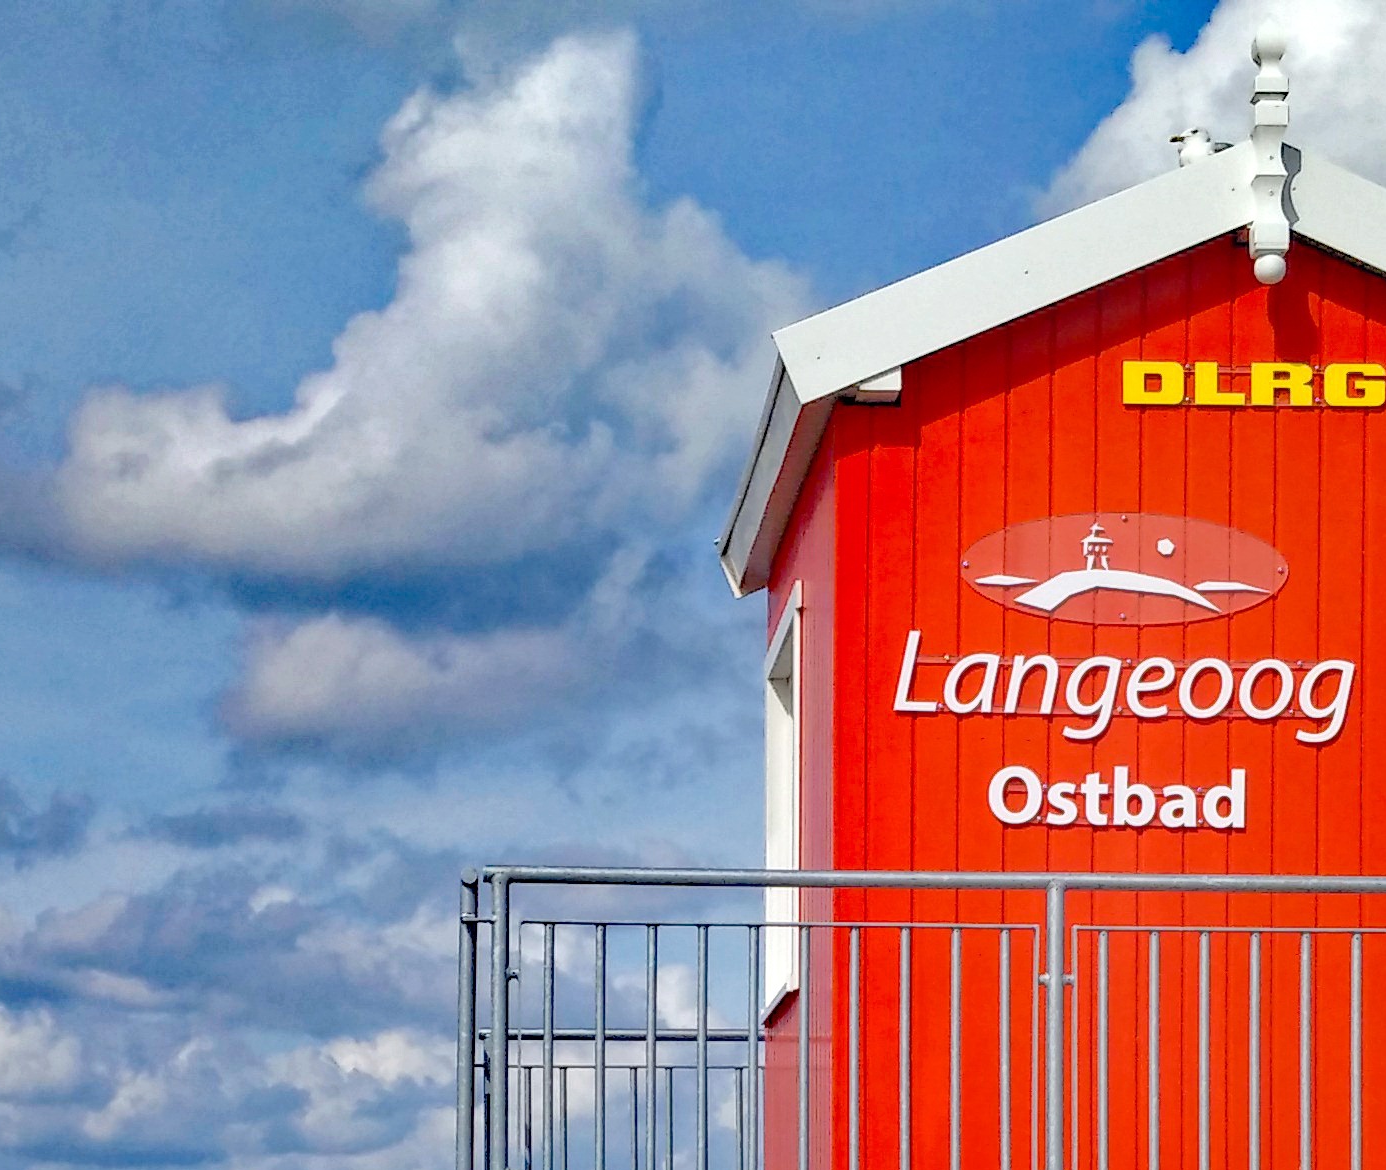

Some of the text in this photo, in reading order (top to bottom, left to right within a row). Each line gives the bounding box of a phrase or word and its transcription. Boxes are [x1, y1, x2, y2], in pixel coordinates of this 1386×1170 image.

[1123, 361, 1386, 406] DLRG
[894, 630, 1356, 742] Langeoog
[989, 766, 1245, 828] Ostbad
